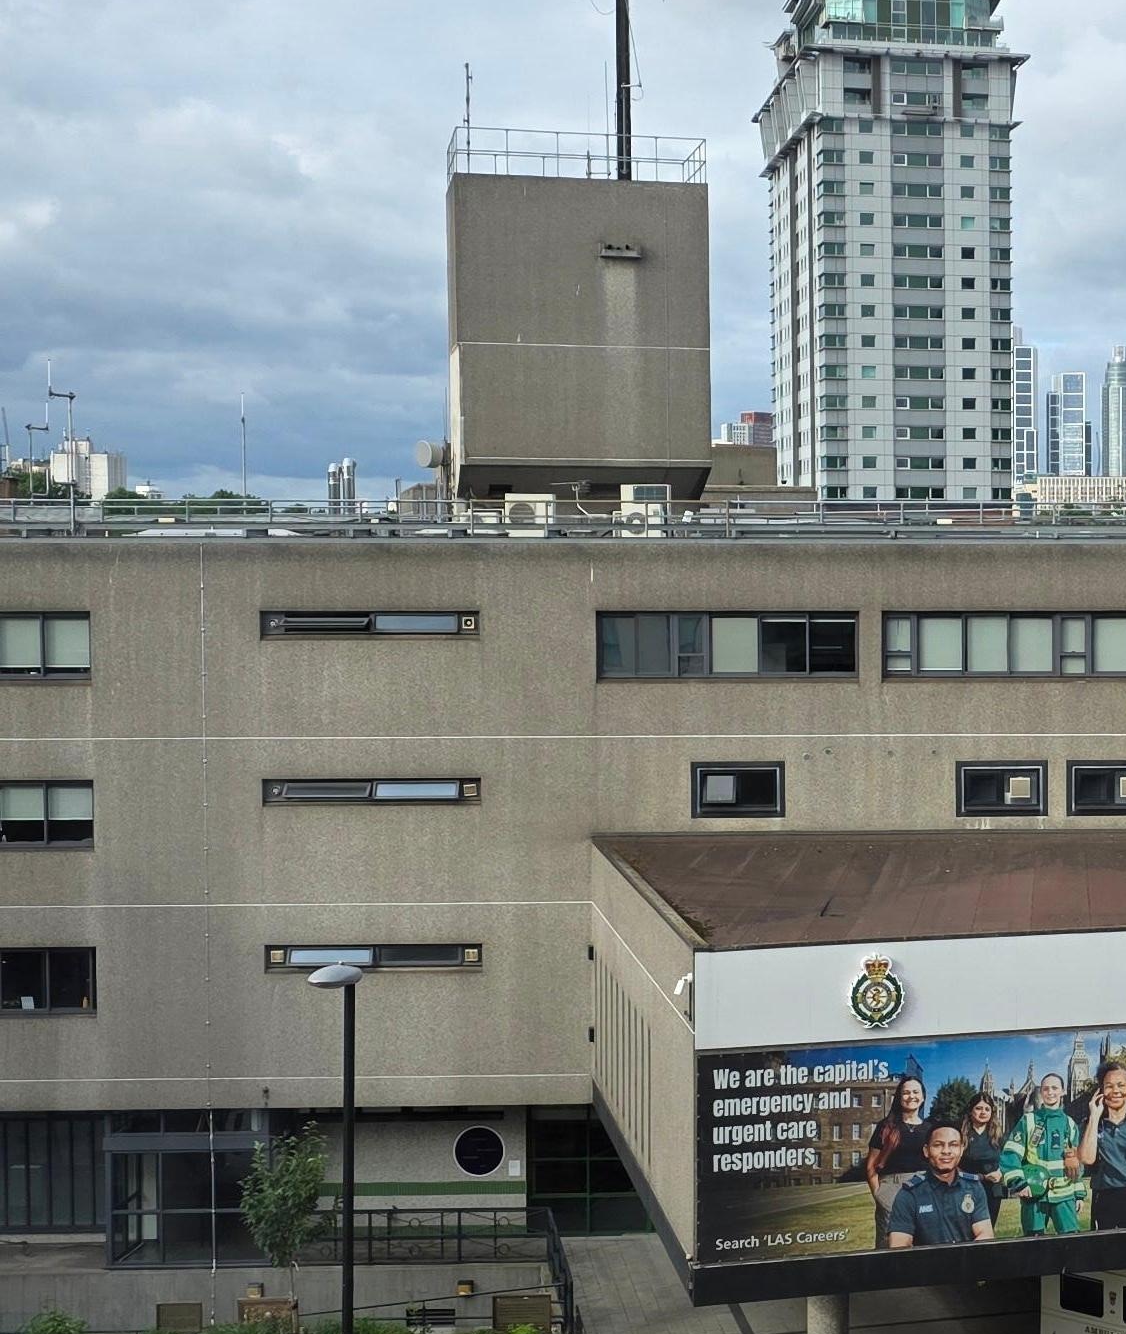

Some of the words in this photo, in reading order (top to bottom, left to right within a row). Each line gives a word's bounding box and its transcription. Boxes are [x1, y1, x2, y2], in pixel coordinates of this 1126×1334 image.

[712, 1068, 740, 1090] We
[745, 1069, 774, 1088] are
[780, 1065, 809, 1085] the
[813, 1059, 889, 1084] capital's
[712, 1092, 813, 1117] emergency
[818, 1088, 852, 1110] and
[712, 1120, 772, 1146] urgent
[776, 1120, 817, 1140] care
[712, 1146, 816, 1174] responders
[715, 1235, 760, 1250] Search
[763, 1232, 793, 1247] 'LAS
[796, 1228, 849, 1244] Careers'
